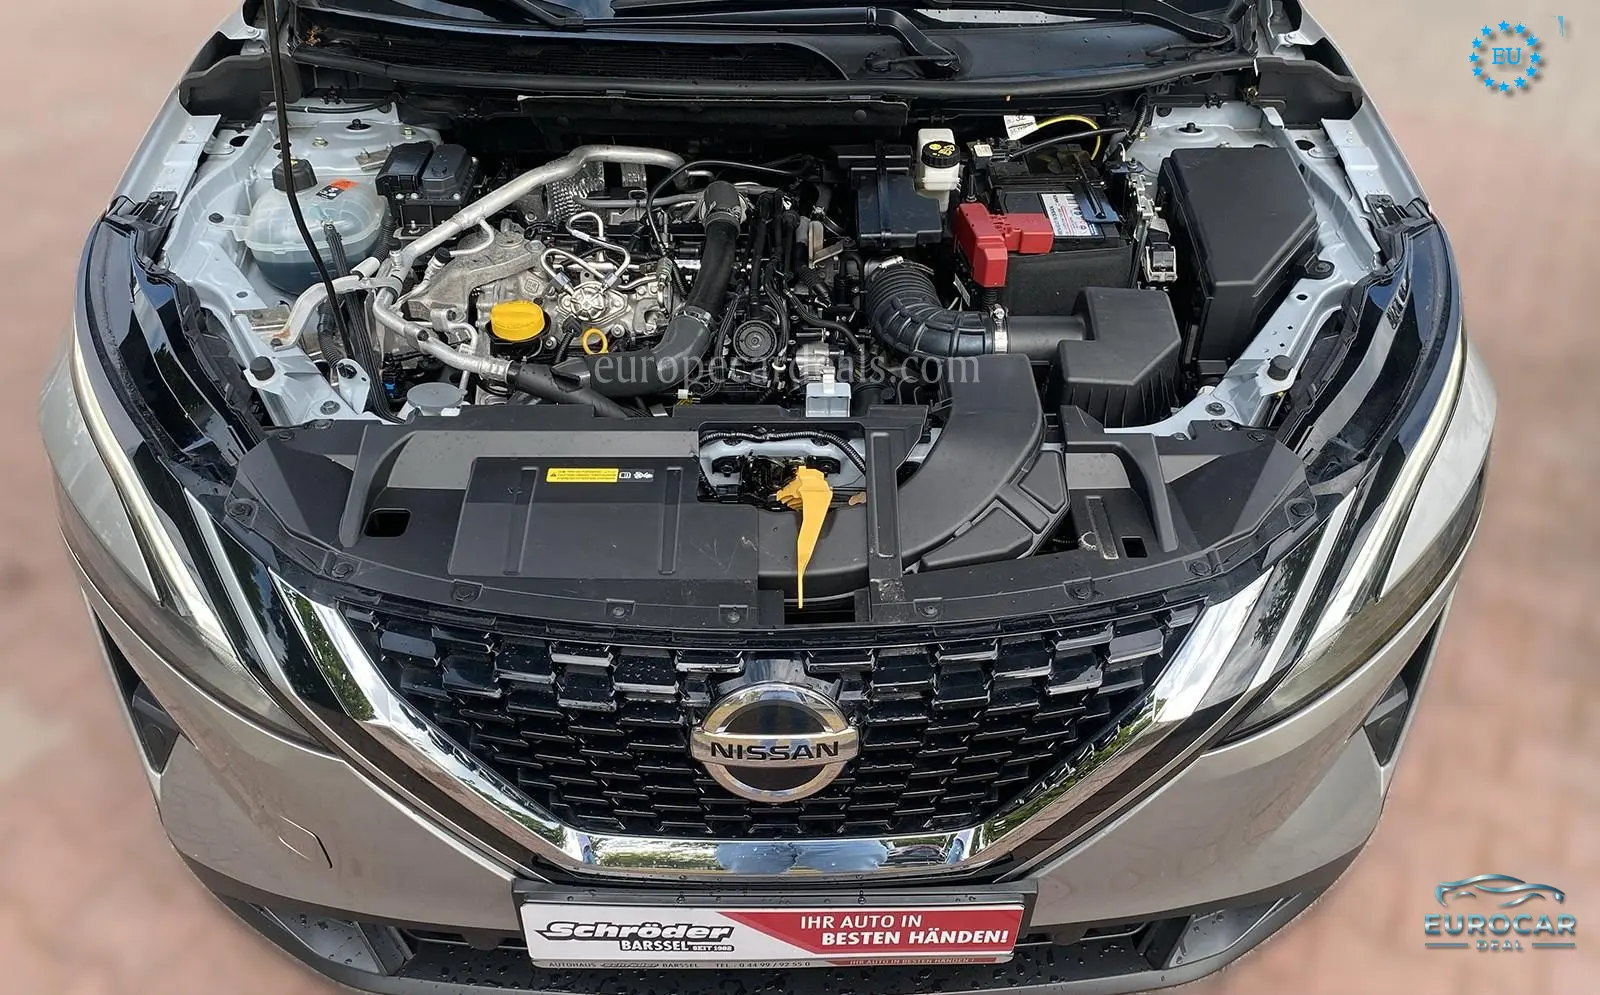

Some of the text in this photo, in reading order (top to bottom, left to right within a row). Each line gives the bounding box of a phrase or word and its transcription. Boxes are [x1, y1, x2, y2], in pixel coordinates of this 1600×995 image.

[711, 741, 839, 760] NISSAN
[537, 921, 734, 942] Schröder
[800, 915, 923, 929] IHR AUTO IN
[621, 940, 689, 951] BARSSEL
[821, 927, 1009, 946] BESTEN HÄNDEN!
